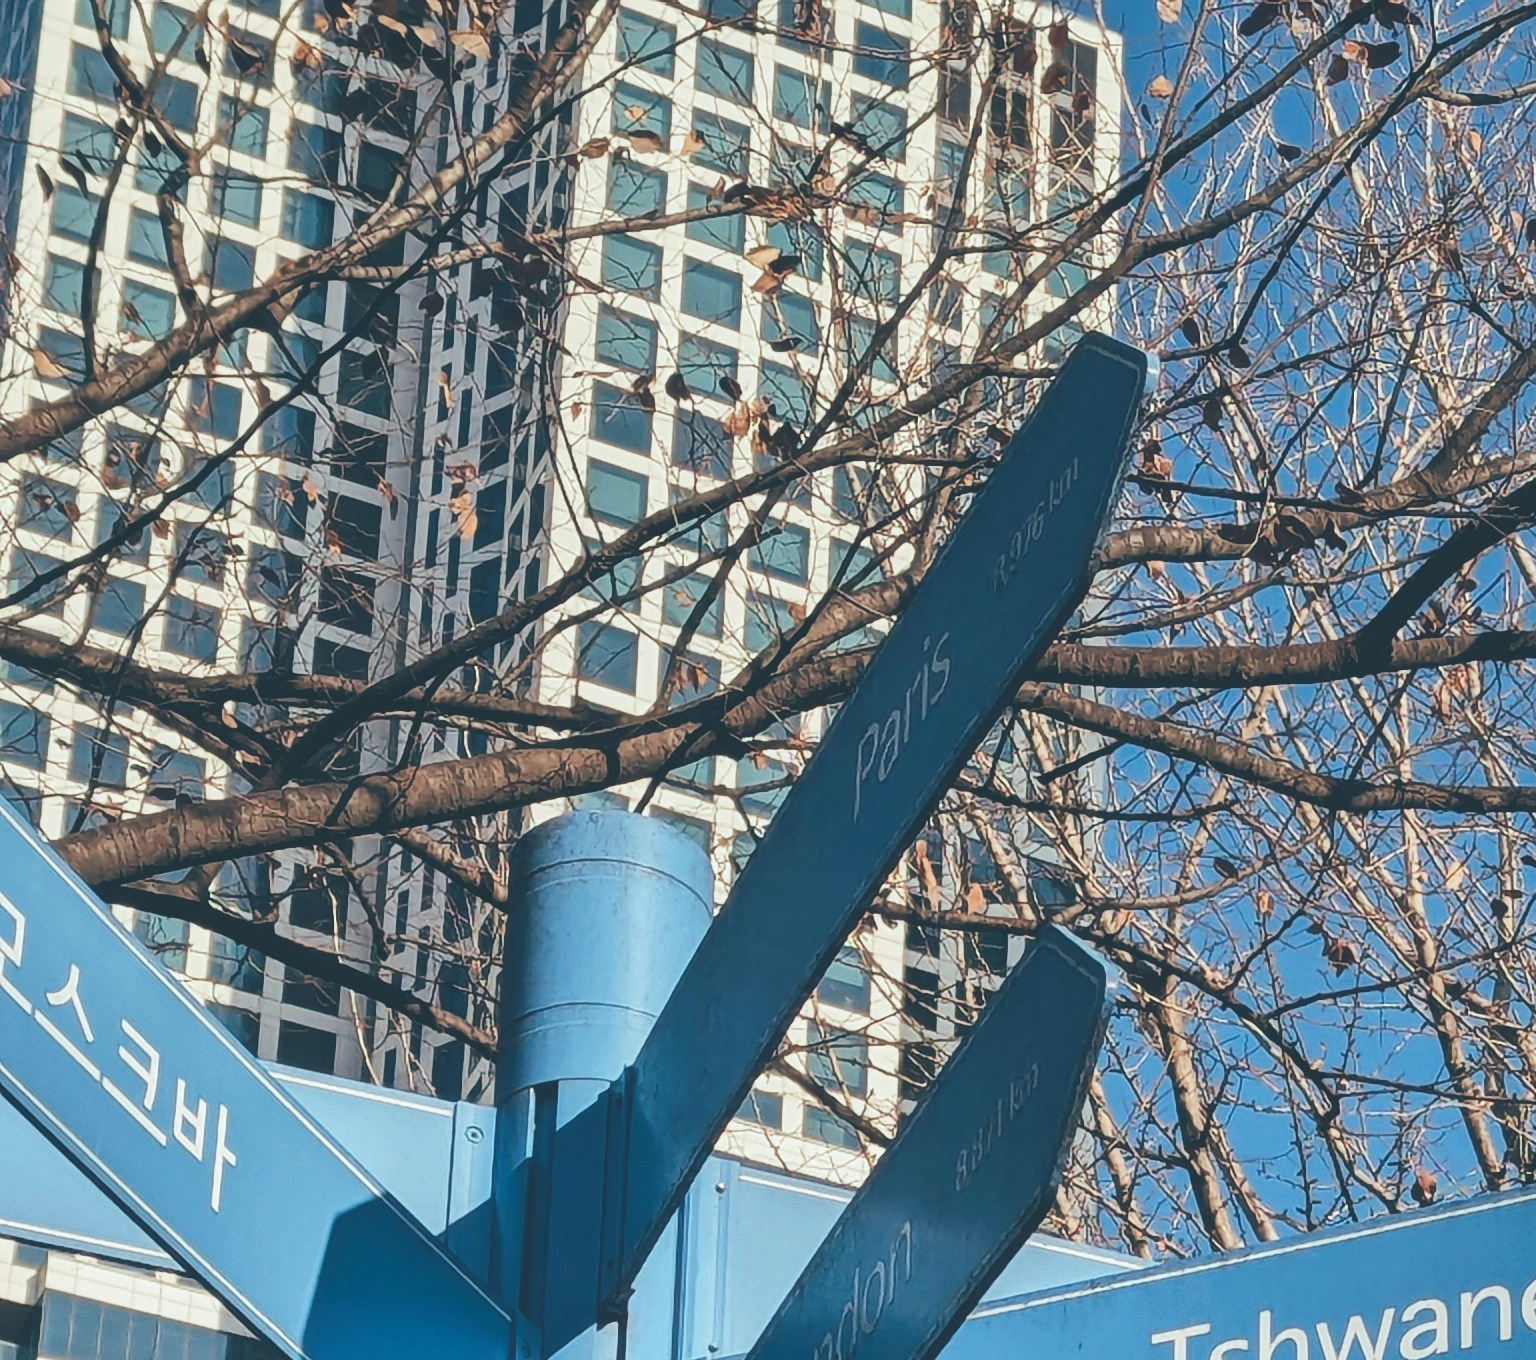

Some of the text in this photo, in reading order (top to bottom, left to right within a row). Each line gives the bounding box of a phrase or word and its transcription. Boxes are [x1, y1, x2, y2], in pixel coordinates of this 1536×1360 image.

[853, 632, 952, 824] Paris
[1049, 457, 1079, 515] km
[1009, 1063, 1038, 1121] km
